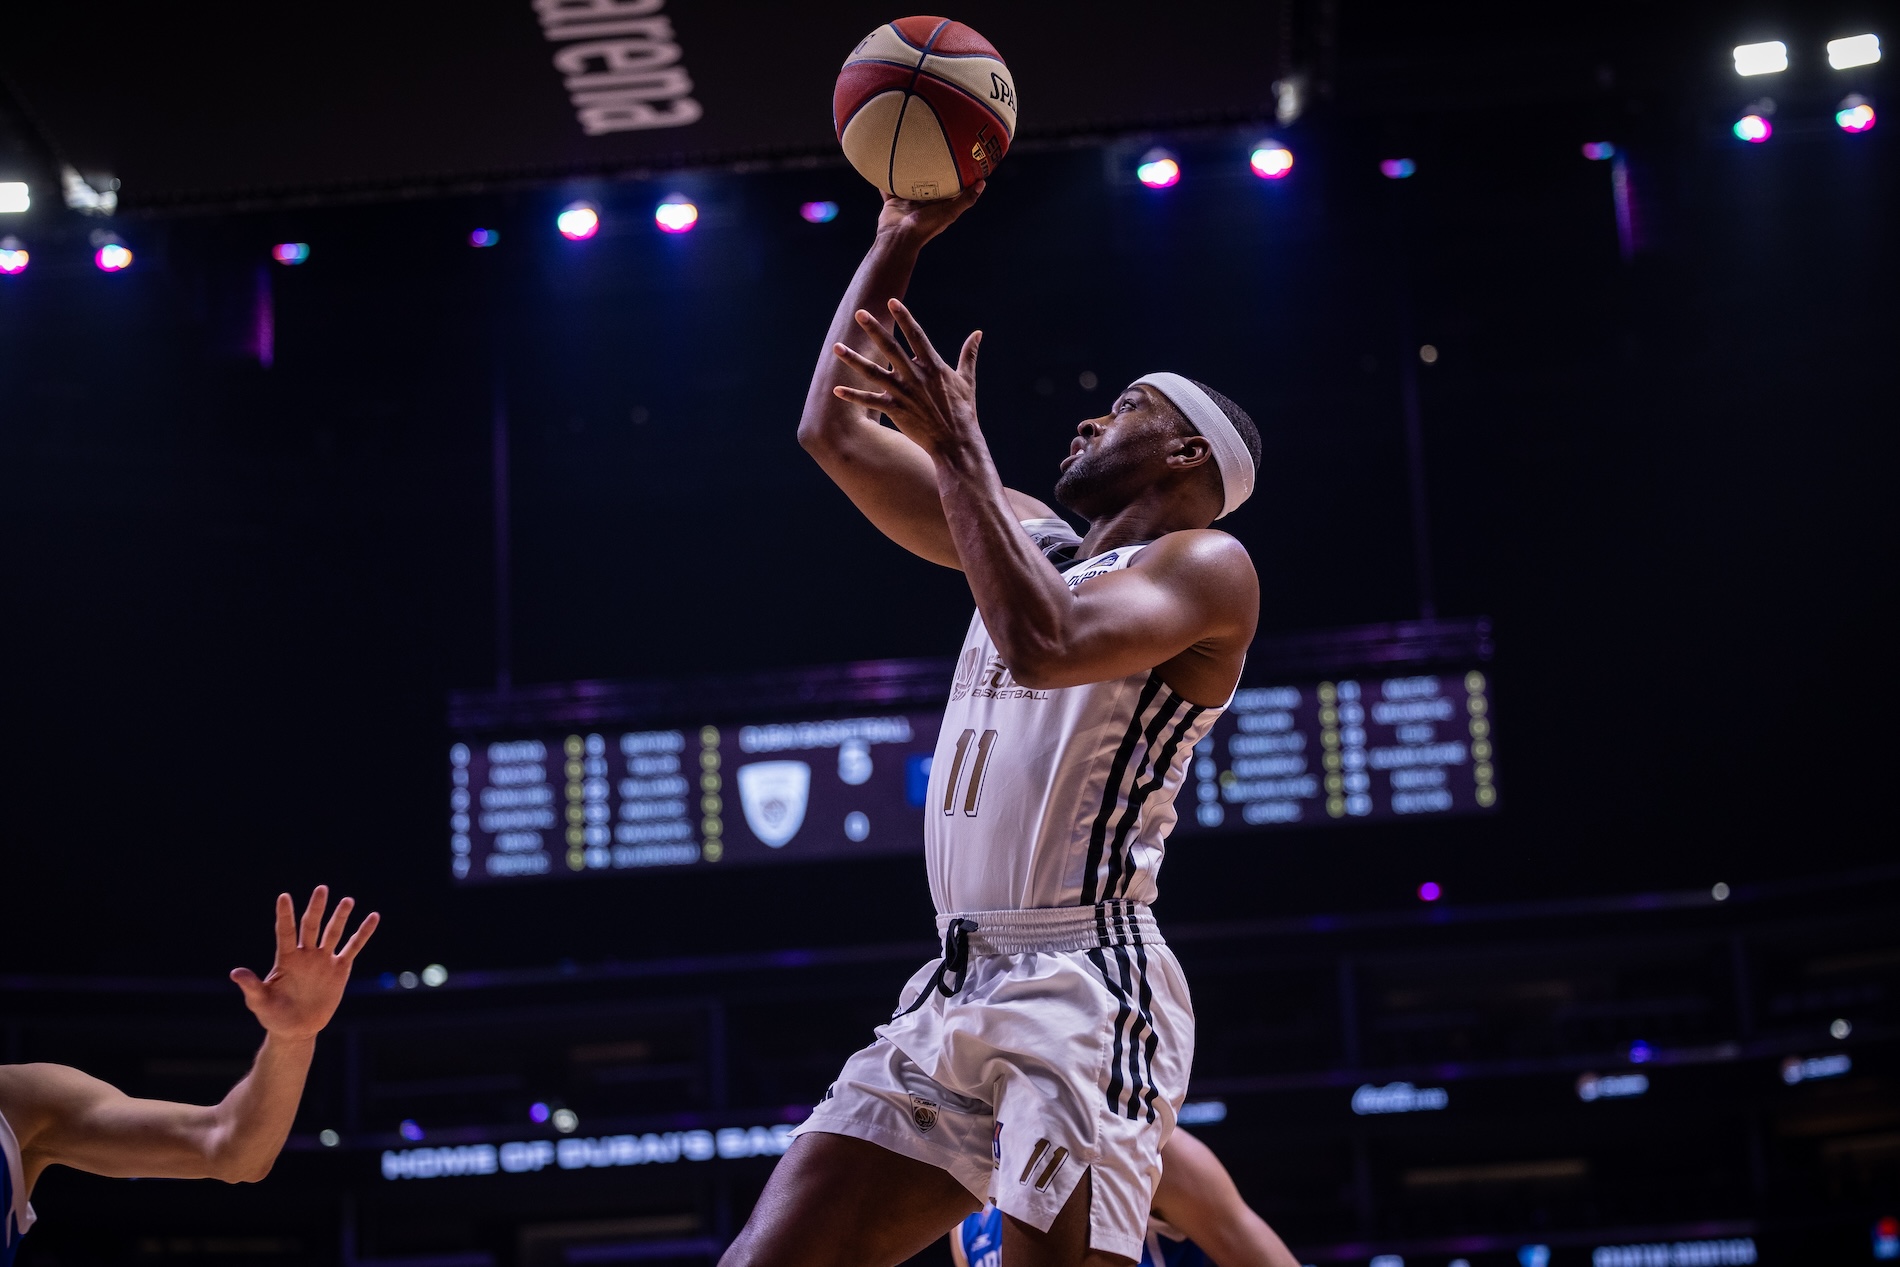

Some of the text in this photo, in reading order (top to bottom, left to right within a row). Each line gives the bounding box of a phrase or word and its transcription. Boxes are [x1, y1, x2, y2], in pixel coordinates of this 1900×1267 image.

[990, 72, 1016, 112] SPA
[944, 729, 998, 817] 11
[1020, 1138, 1069, 1193] 11
